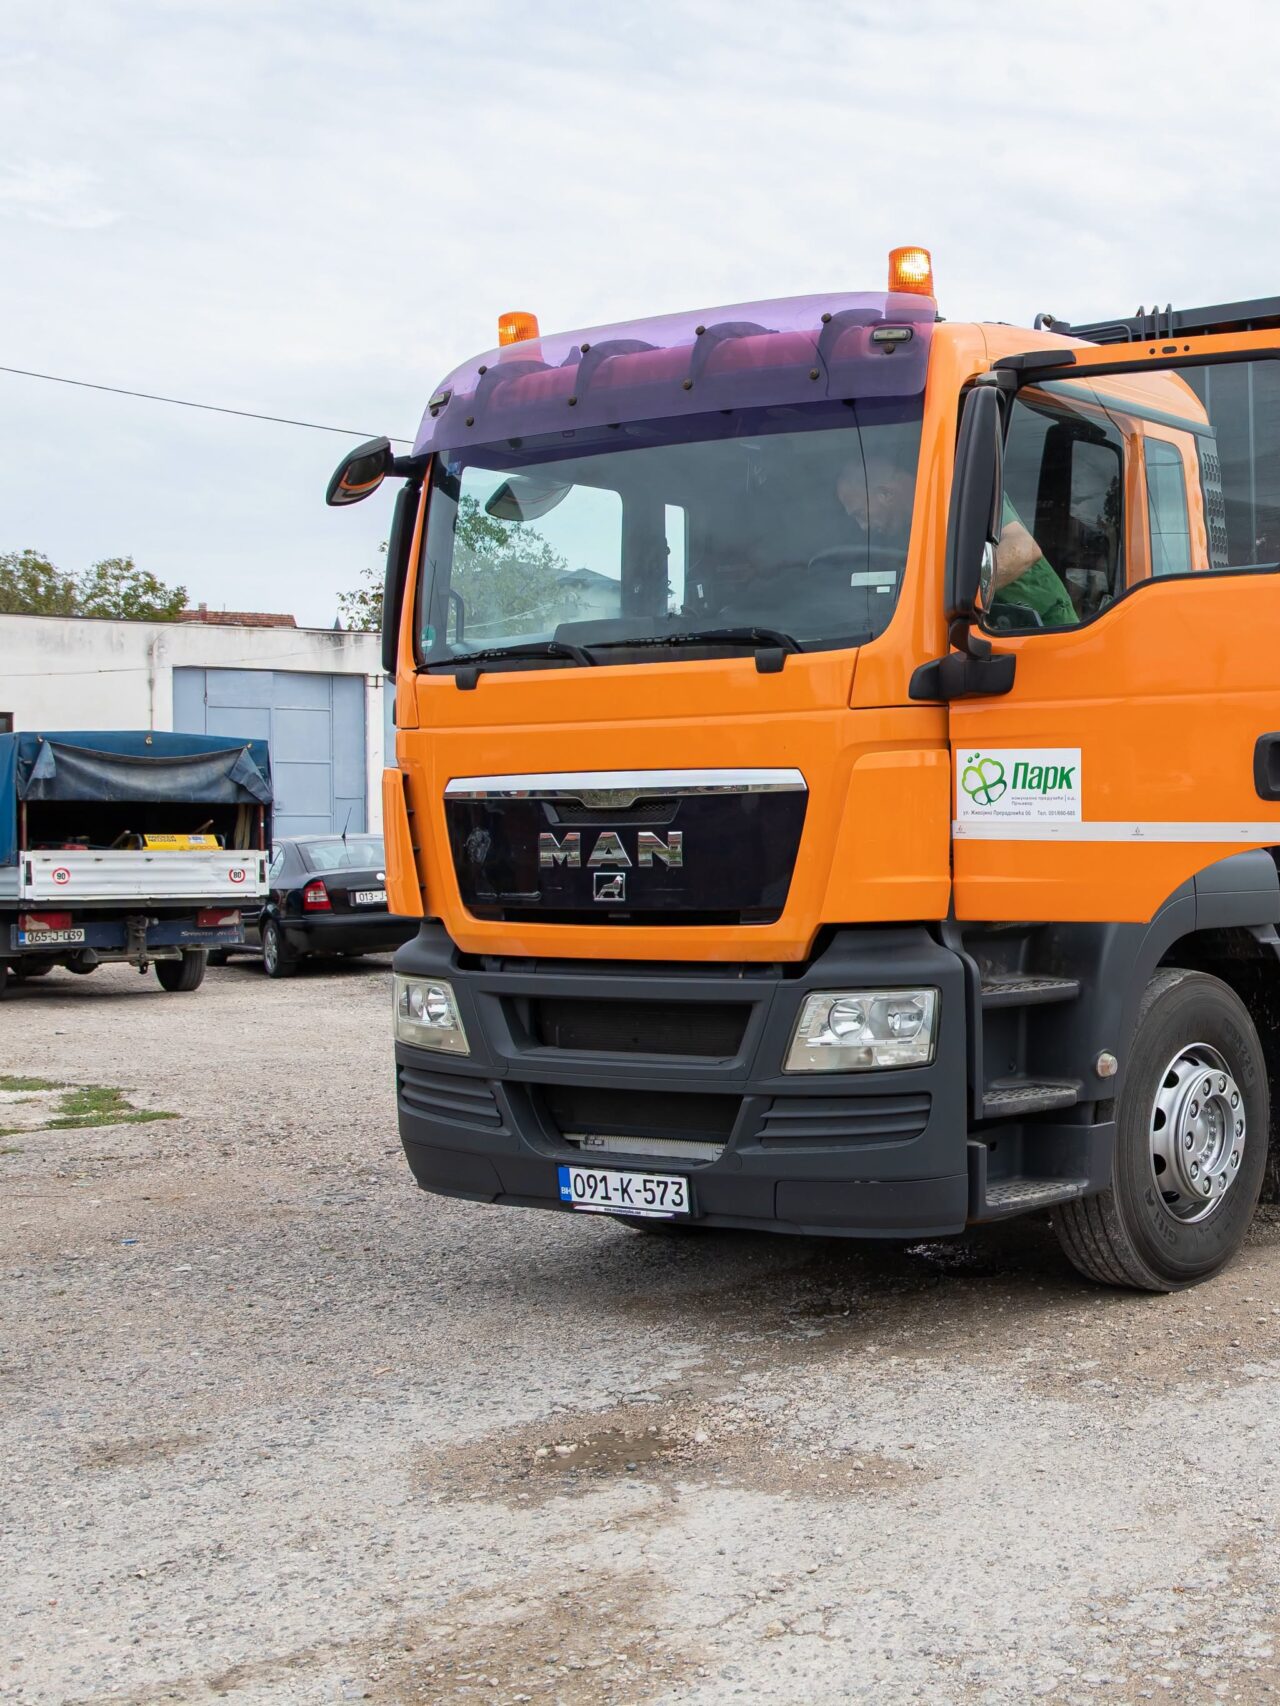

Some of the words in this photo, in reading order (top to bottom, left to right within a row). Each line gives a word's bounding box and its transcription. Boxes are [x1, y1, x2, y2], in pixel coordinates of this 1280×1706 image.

[1011, 762, 1076, 795] Парк
[539, 831, 684, 868] MAN
[56, 873, 66, 881] 90
[233, 871, 242, 879] 80
[359, 890, 388, 902] 013-J-
[573, 1173, 685, 1207] 091-K-573
